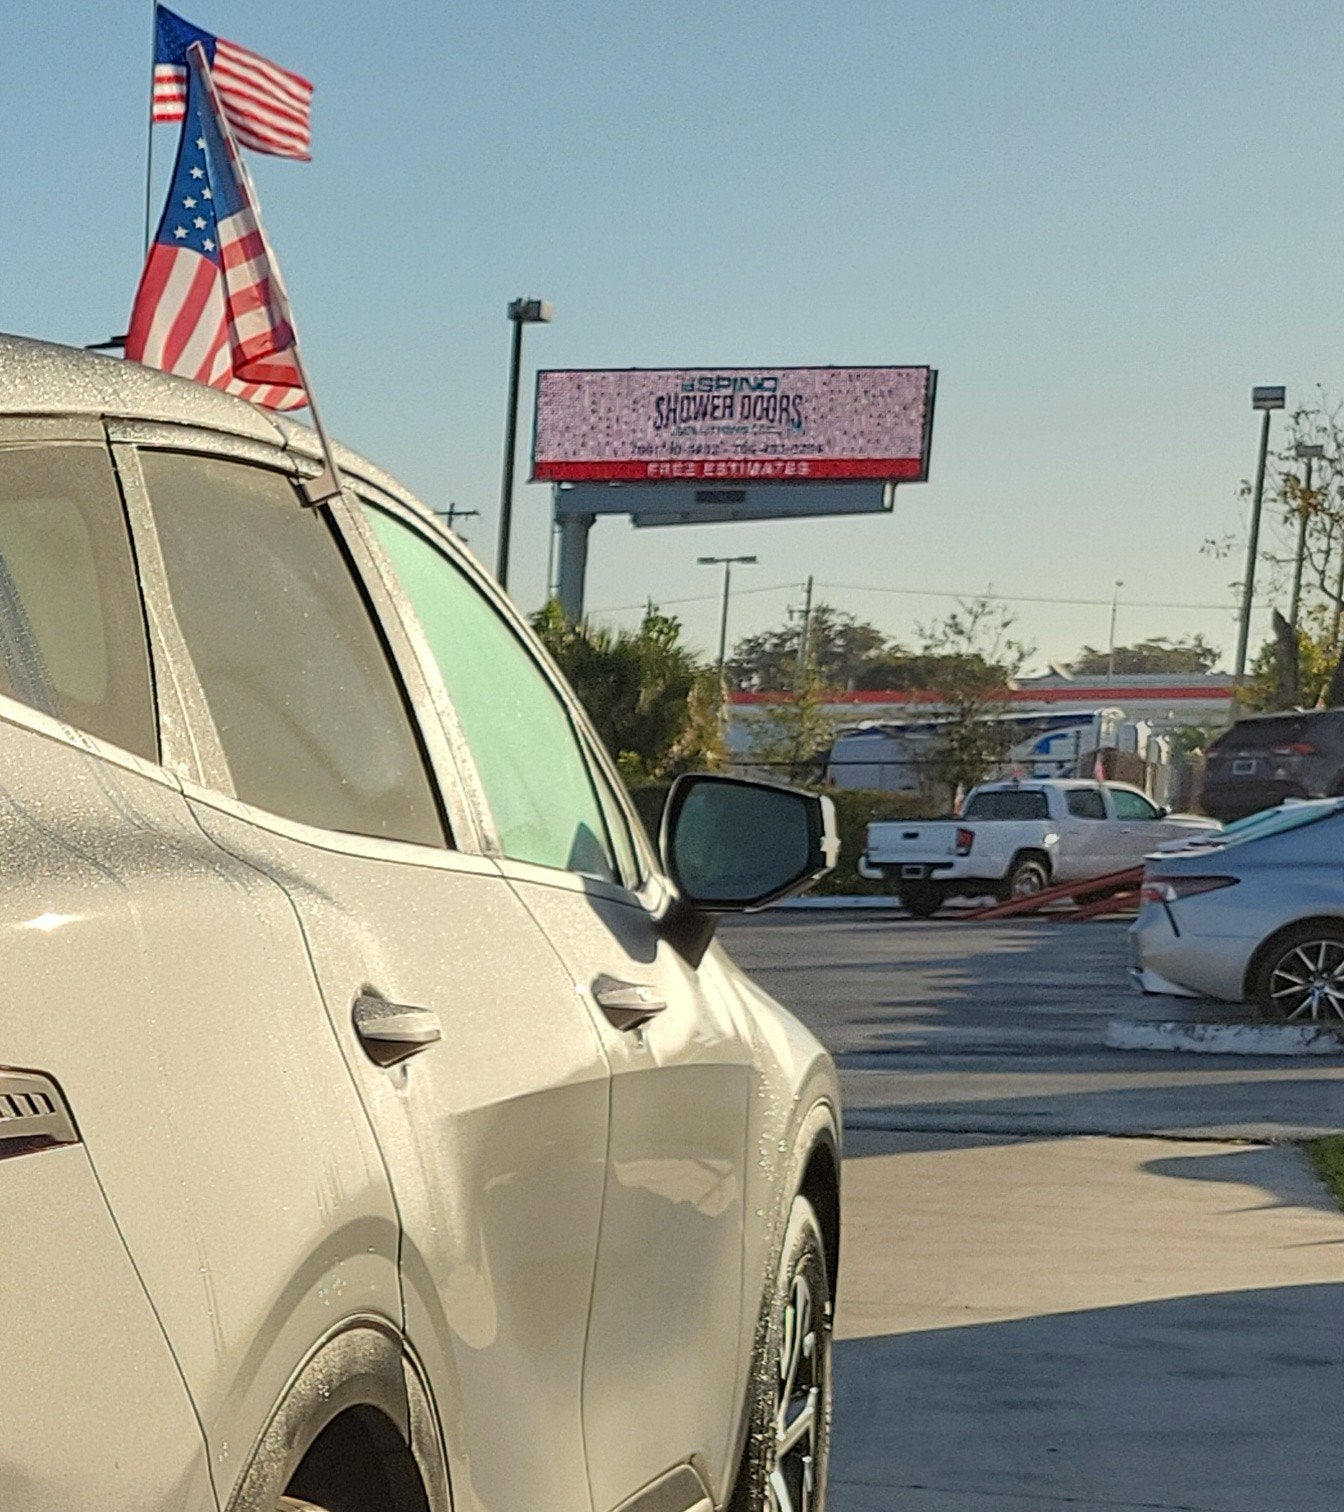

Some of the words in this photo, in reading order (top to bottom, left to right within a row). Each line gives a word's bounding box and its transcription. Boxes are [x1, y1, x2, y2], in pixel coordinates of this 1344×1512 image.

[653, 394, 734, 430] SHOWER
[739, 394, 803, 428] DOORS
[647, 462, 696, 476] FREE
[703, 461, 810, 476] ESTIMATES
